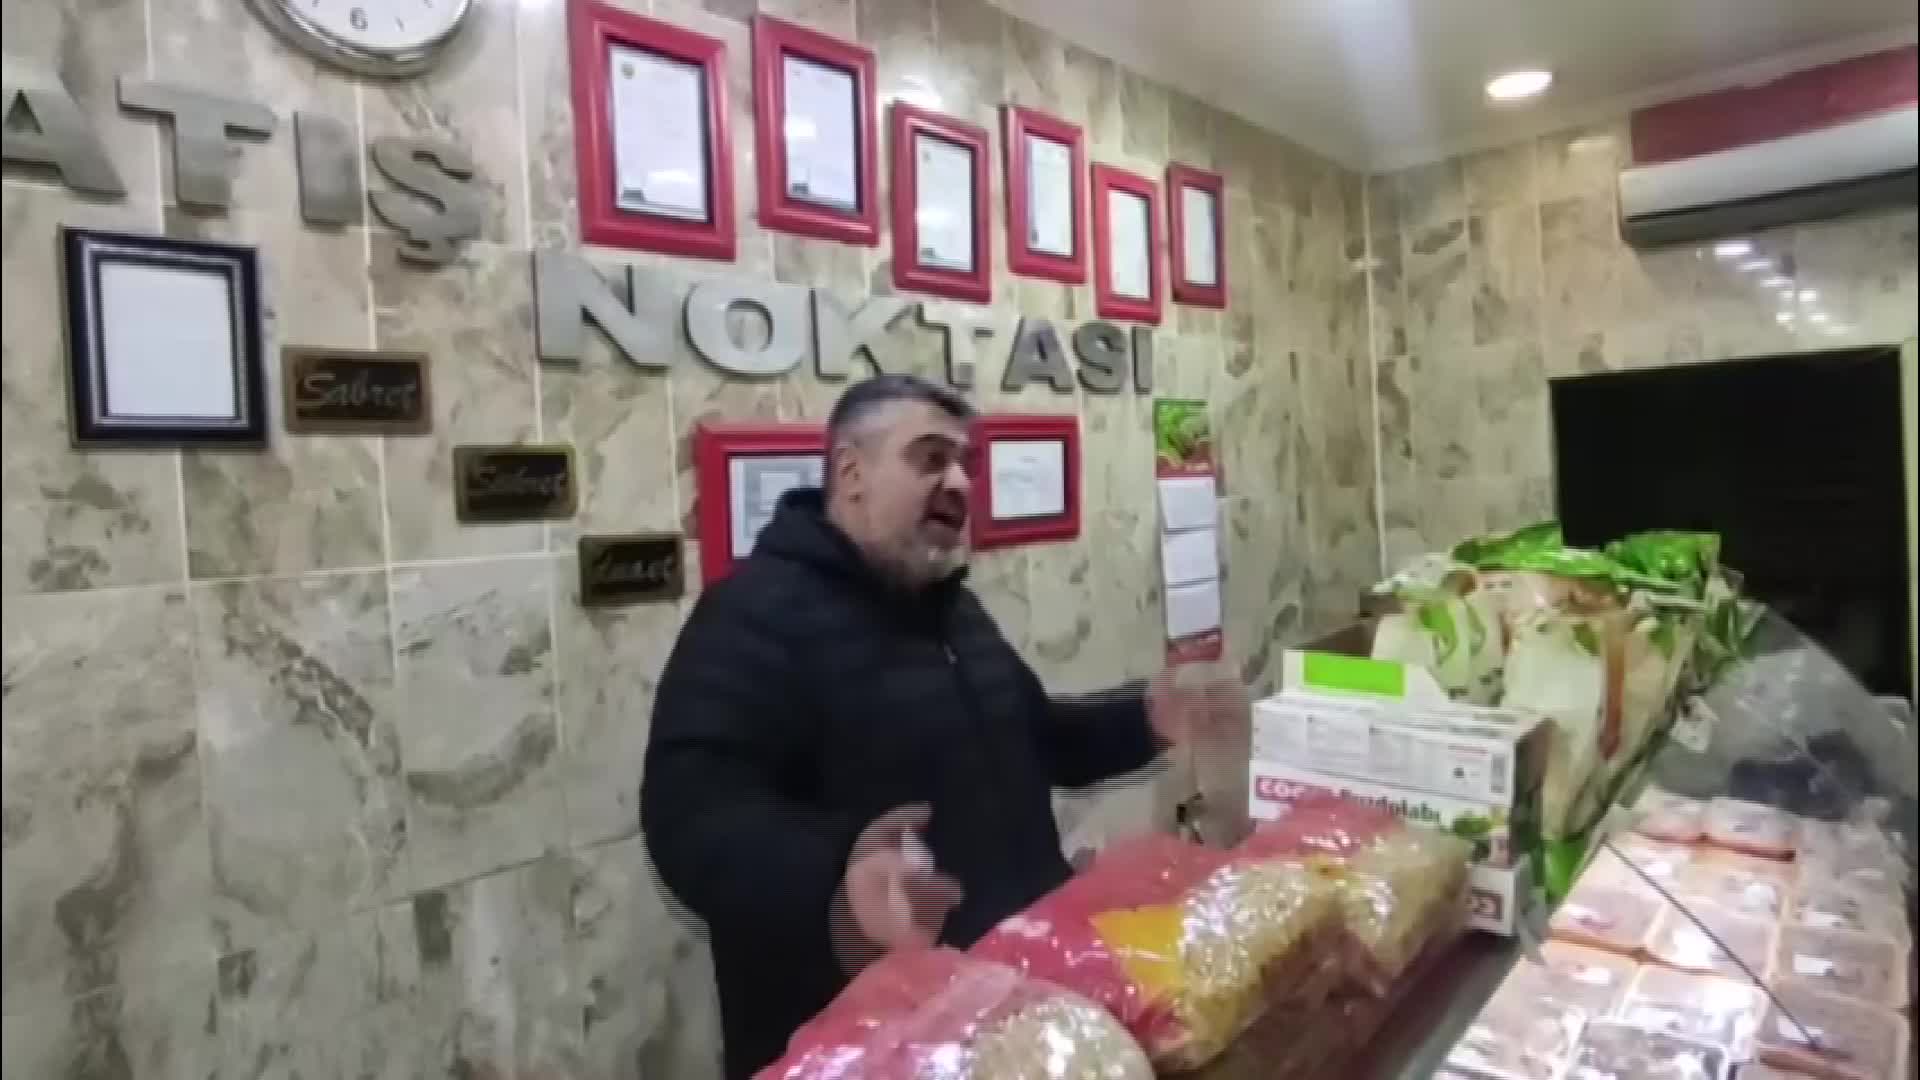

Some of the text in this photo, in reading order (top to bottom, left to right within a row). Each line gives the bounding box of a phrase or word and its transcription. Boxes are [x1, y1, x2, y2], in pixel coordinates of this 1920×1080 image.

[349, 7, 369, 32] 6
[1, 72, 484, 268] ATIŞ
[531, 250, 1152, 394] NOKTASI
